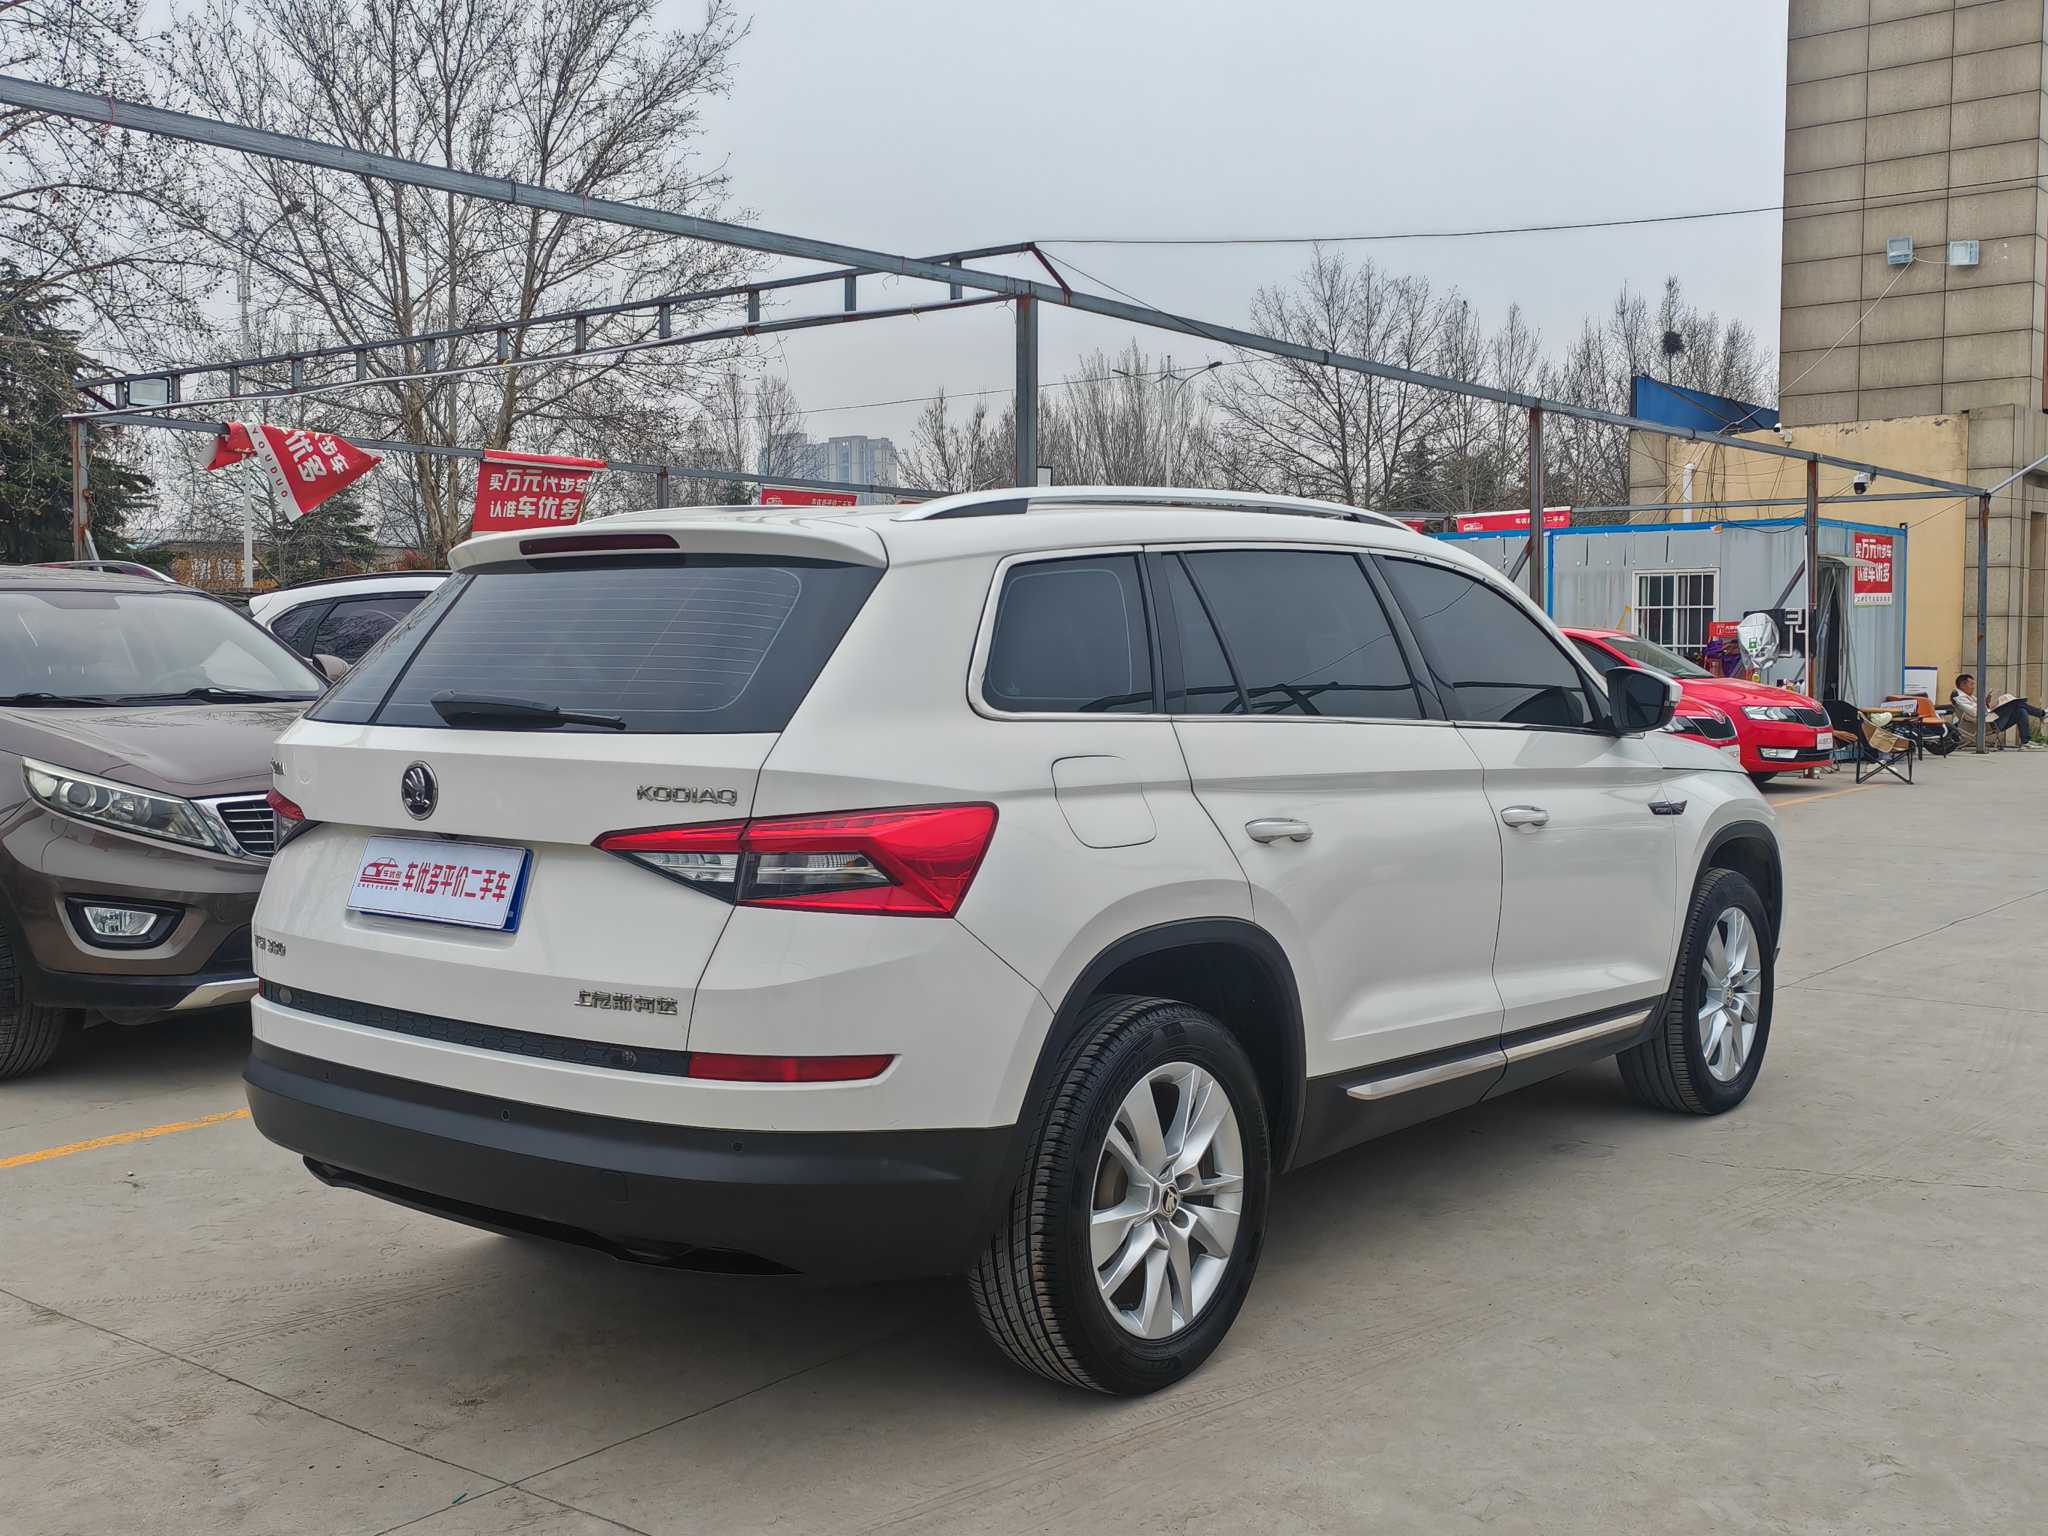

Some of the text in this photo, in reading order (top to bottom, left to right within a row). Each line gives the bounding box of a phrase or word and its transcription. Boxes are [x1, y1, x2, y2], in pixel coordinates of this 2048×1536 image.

[490, 496, 580, 520] 认准车优多
[637, 786, 737, 806] KODIAQ
[402, 861, 510, 902] 车优多平价二手车
[574, 989, 678, 1015] 上汽斯柯达
